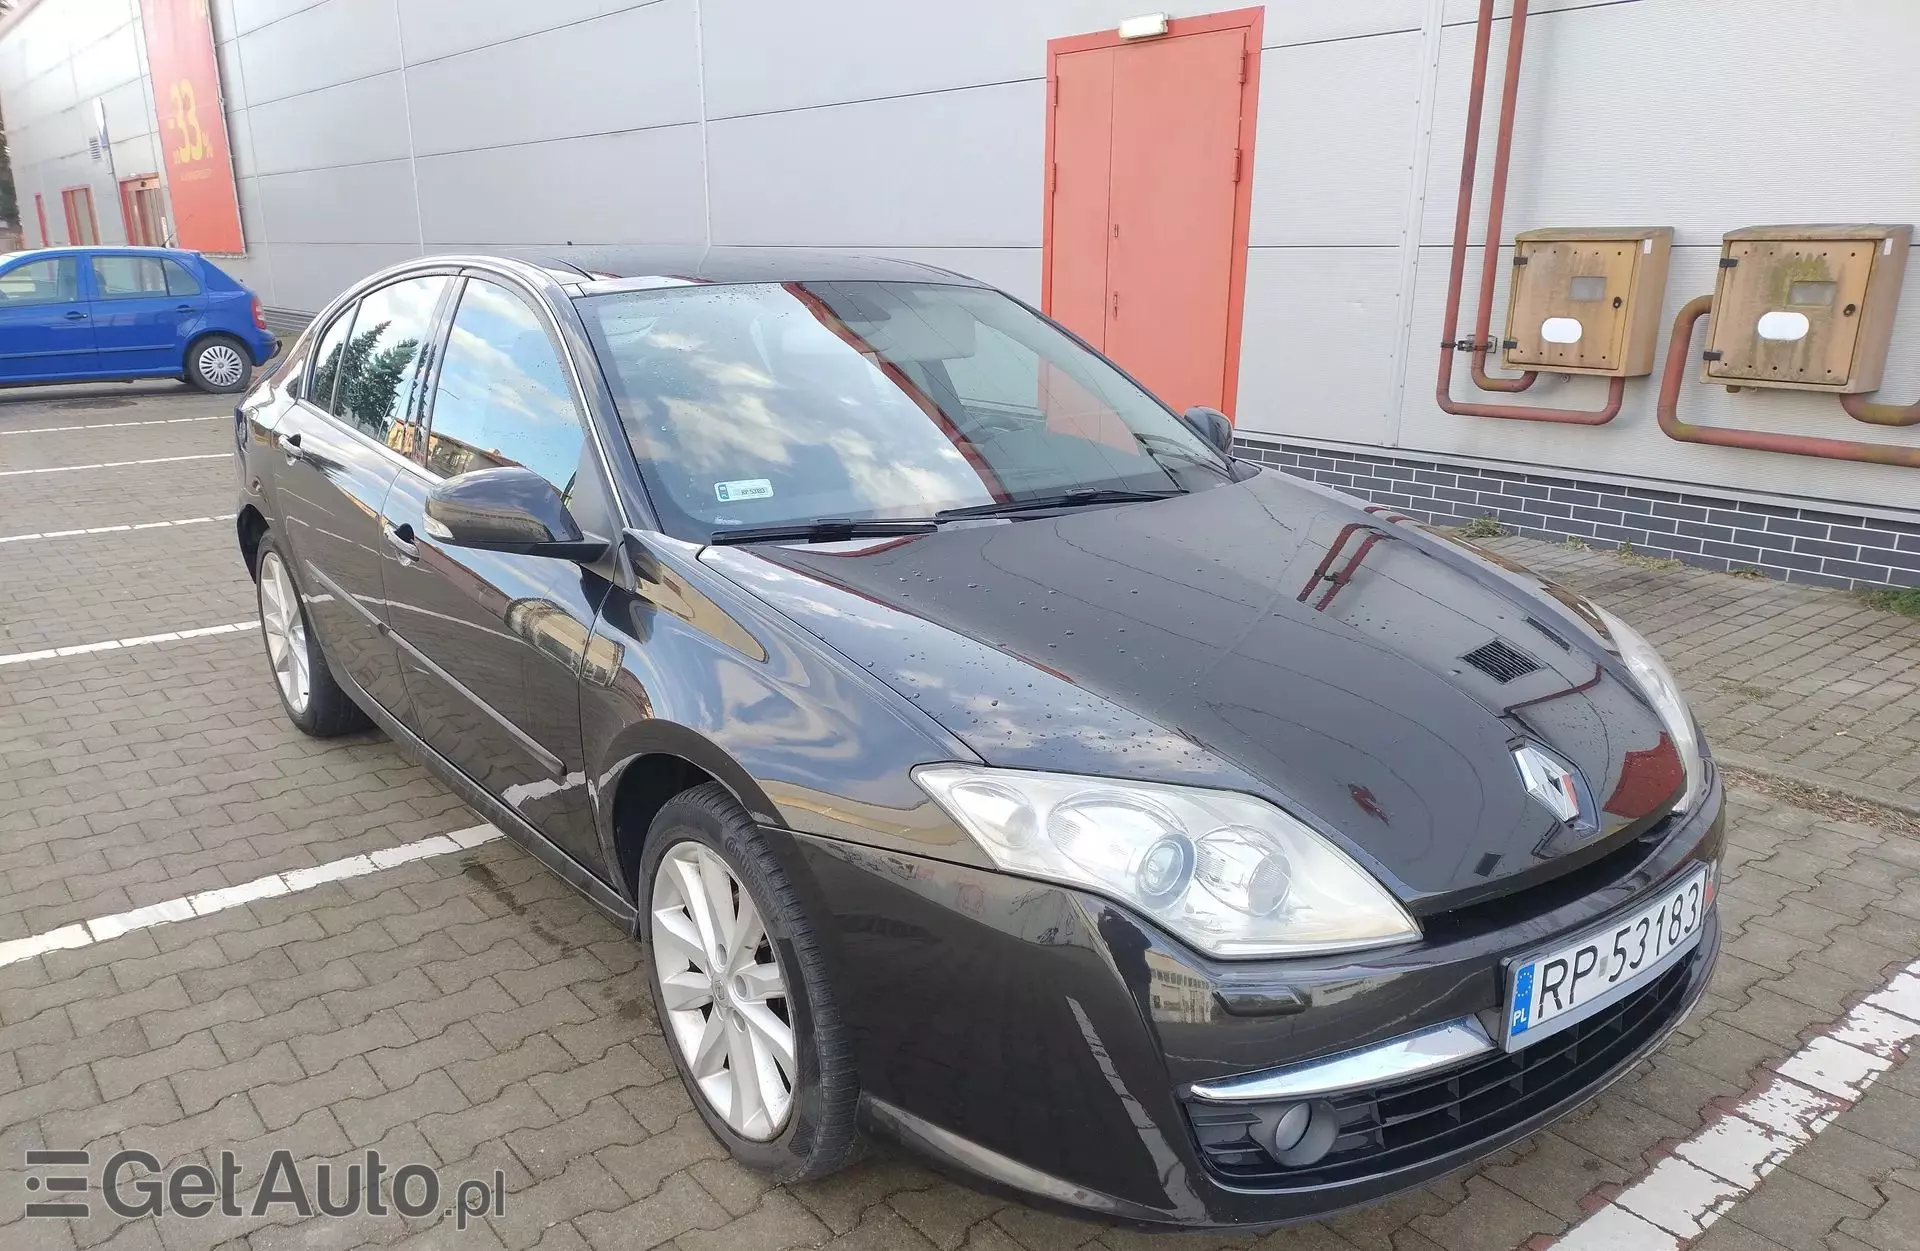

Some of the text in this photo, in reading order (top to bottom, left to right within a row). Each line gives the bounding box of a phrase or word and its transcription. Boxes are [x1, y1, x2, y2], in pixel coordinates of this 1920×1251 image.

[1537, 882, 1699, 1019] RP 53183
[1513, 1007, 1528, 1027] PL
